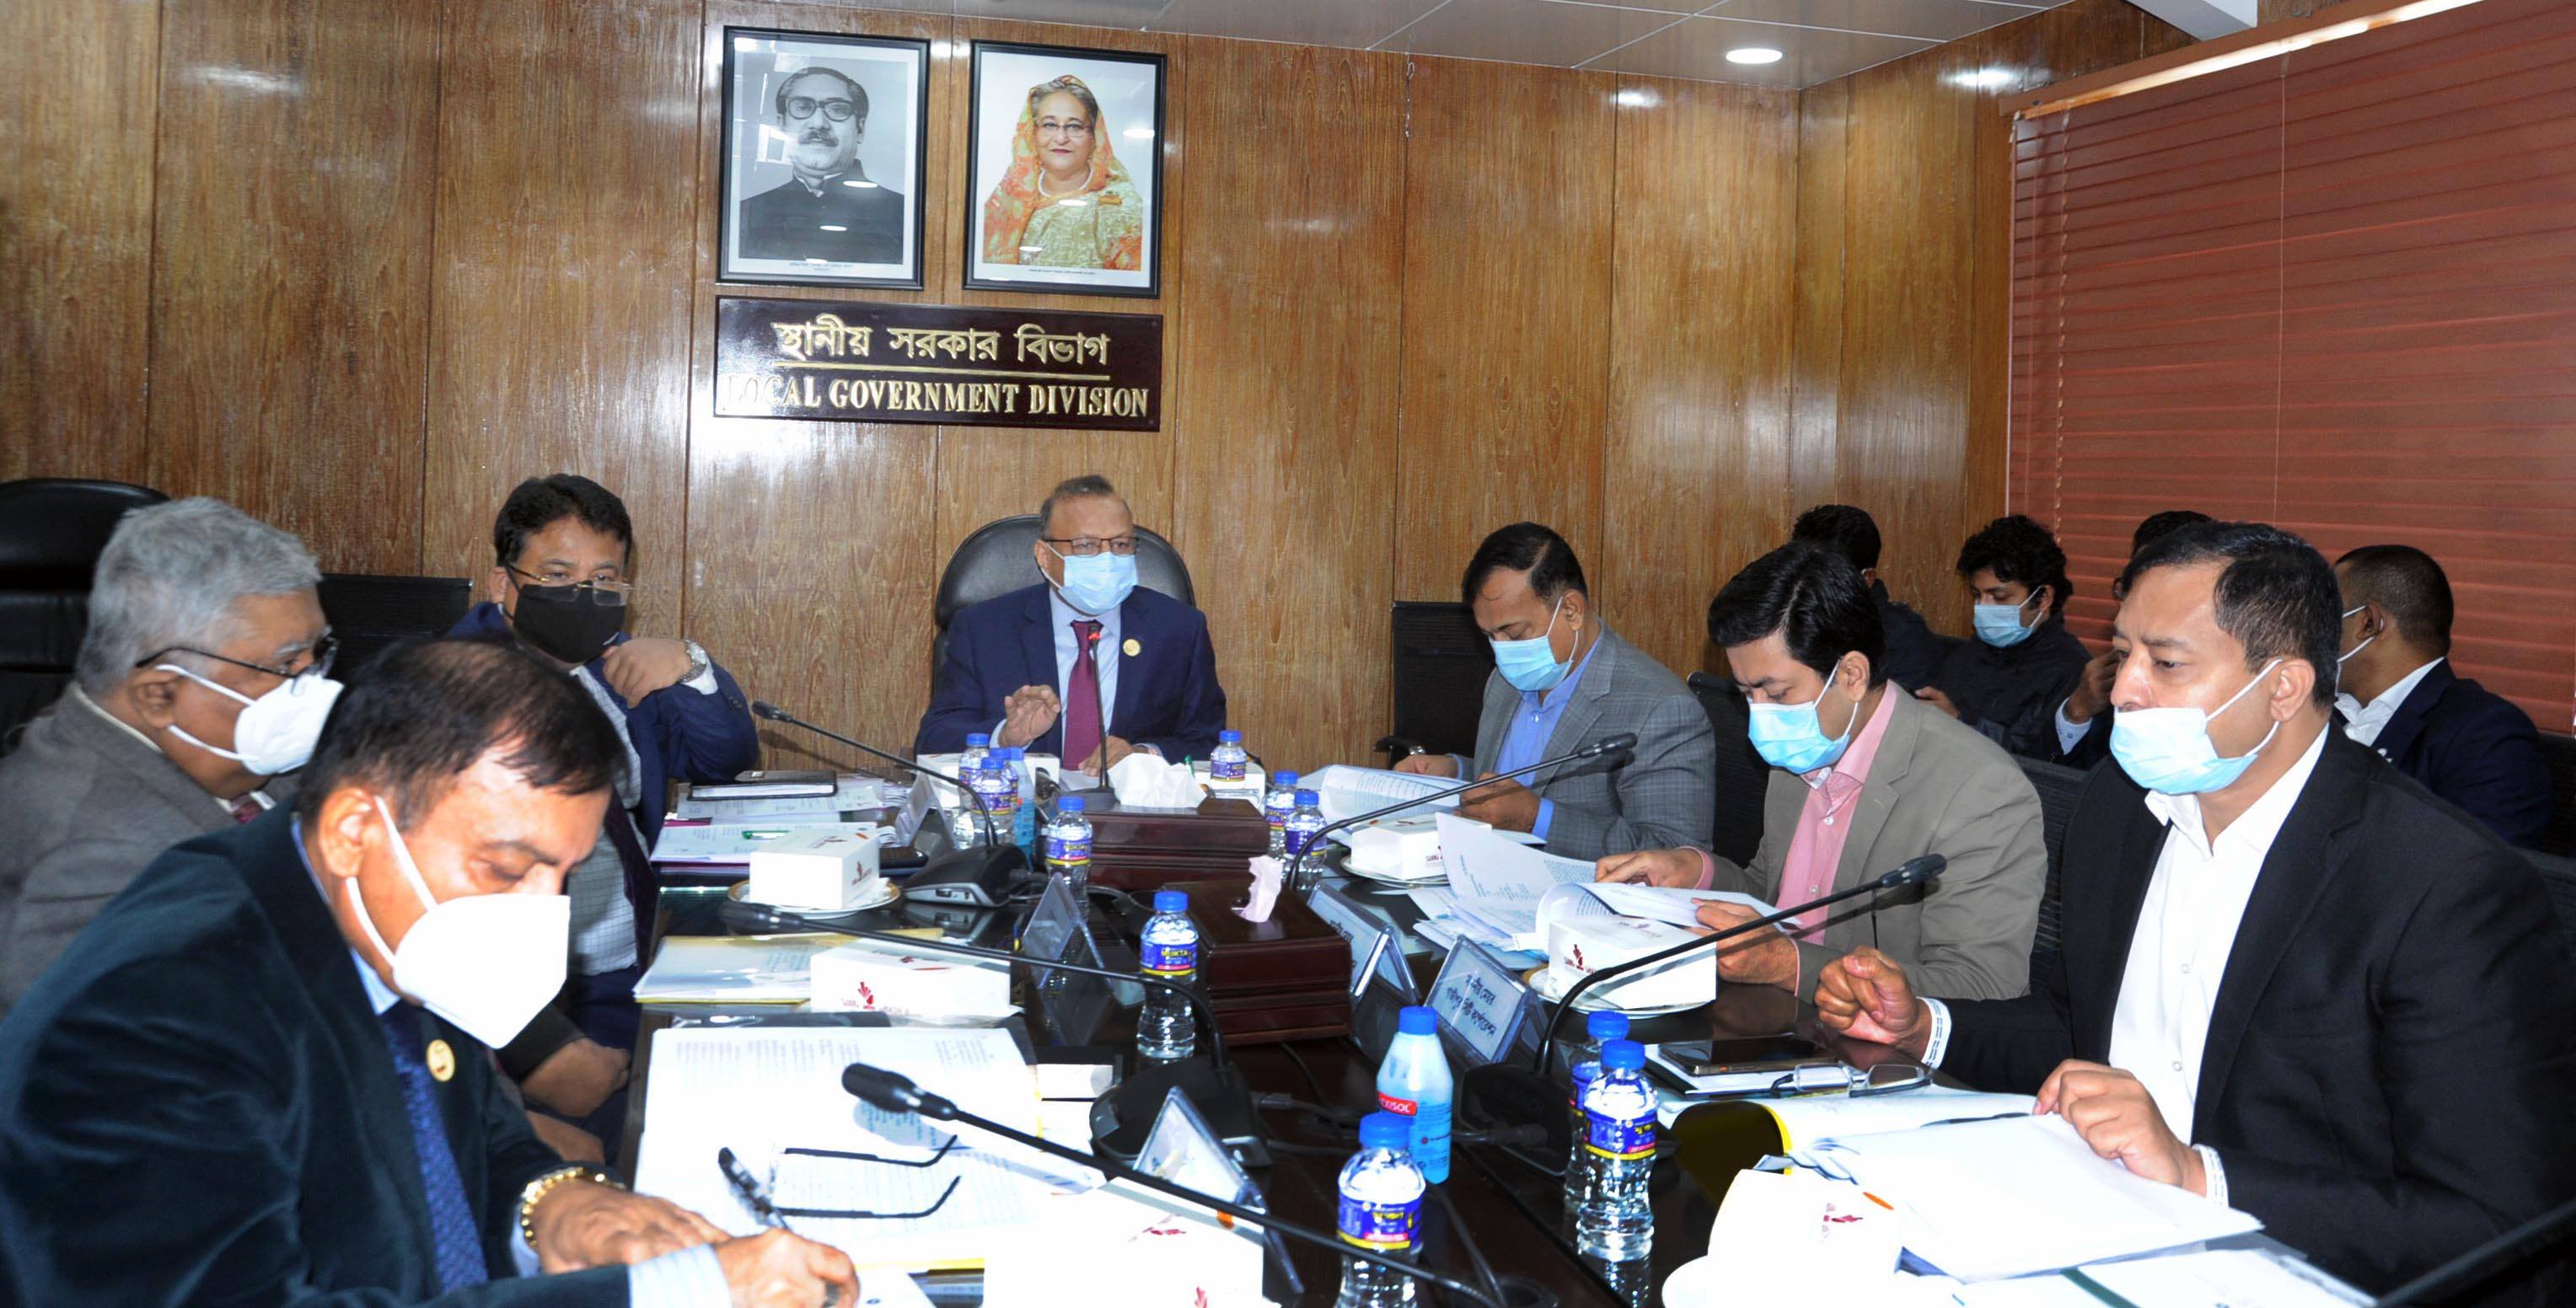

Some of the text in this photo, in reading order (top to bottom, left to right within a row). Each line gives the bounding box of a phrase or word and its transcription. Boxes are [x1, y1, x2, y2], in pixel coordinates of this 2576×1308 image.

[771, 313, 1111, 366] স্থানীয় সরকার বিভাগ
[829, 379, 1020, 413] GOVERNMENT
[1029, 385, 1149, 417] DIVISION
